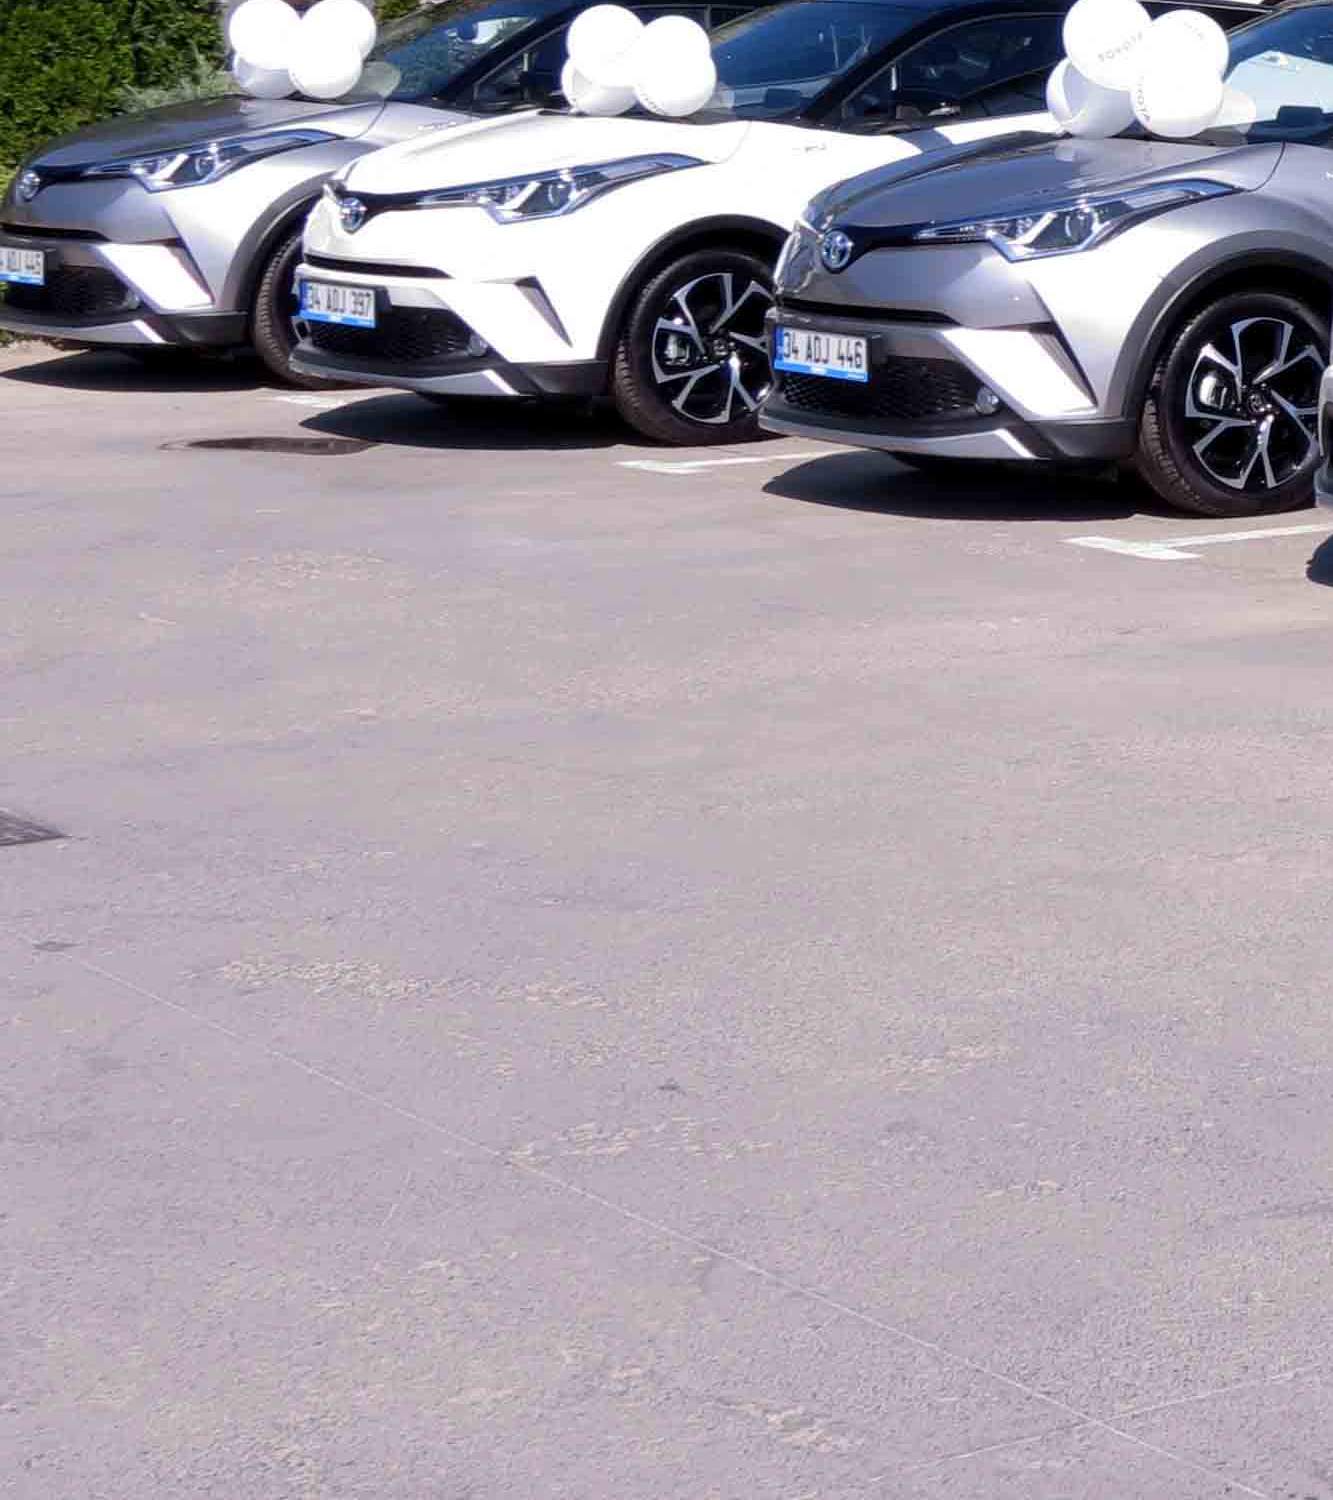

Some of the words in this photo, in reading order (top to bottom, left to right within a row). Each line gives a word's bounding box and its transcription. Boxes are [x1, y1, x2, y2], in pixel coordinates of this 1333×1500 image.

[784, 331, 800, 360] 34
[806, 334, 830, 364] ADJ
[837, 340, 863, 369] 446
